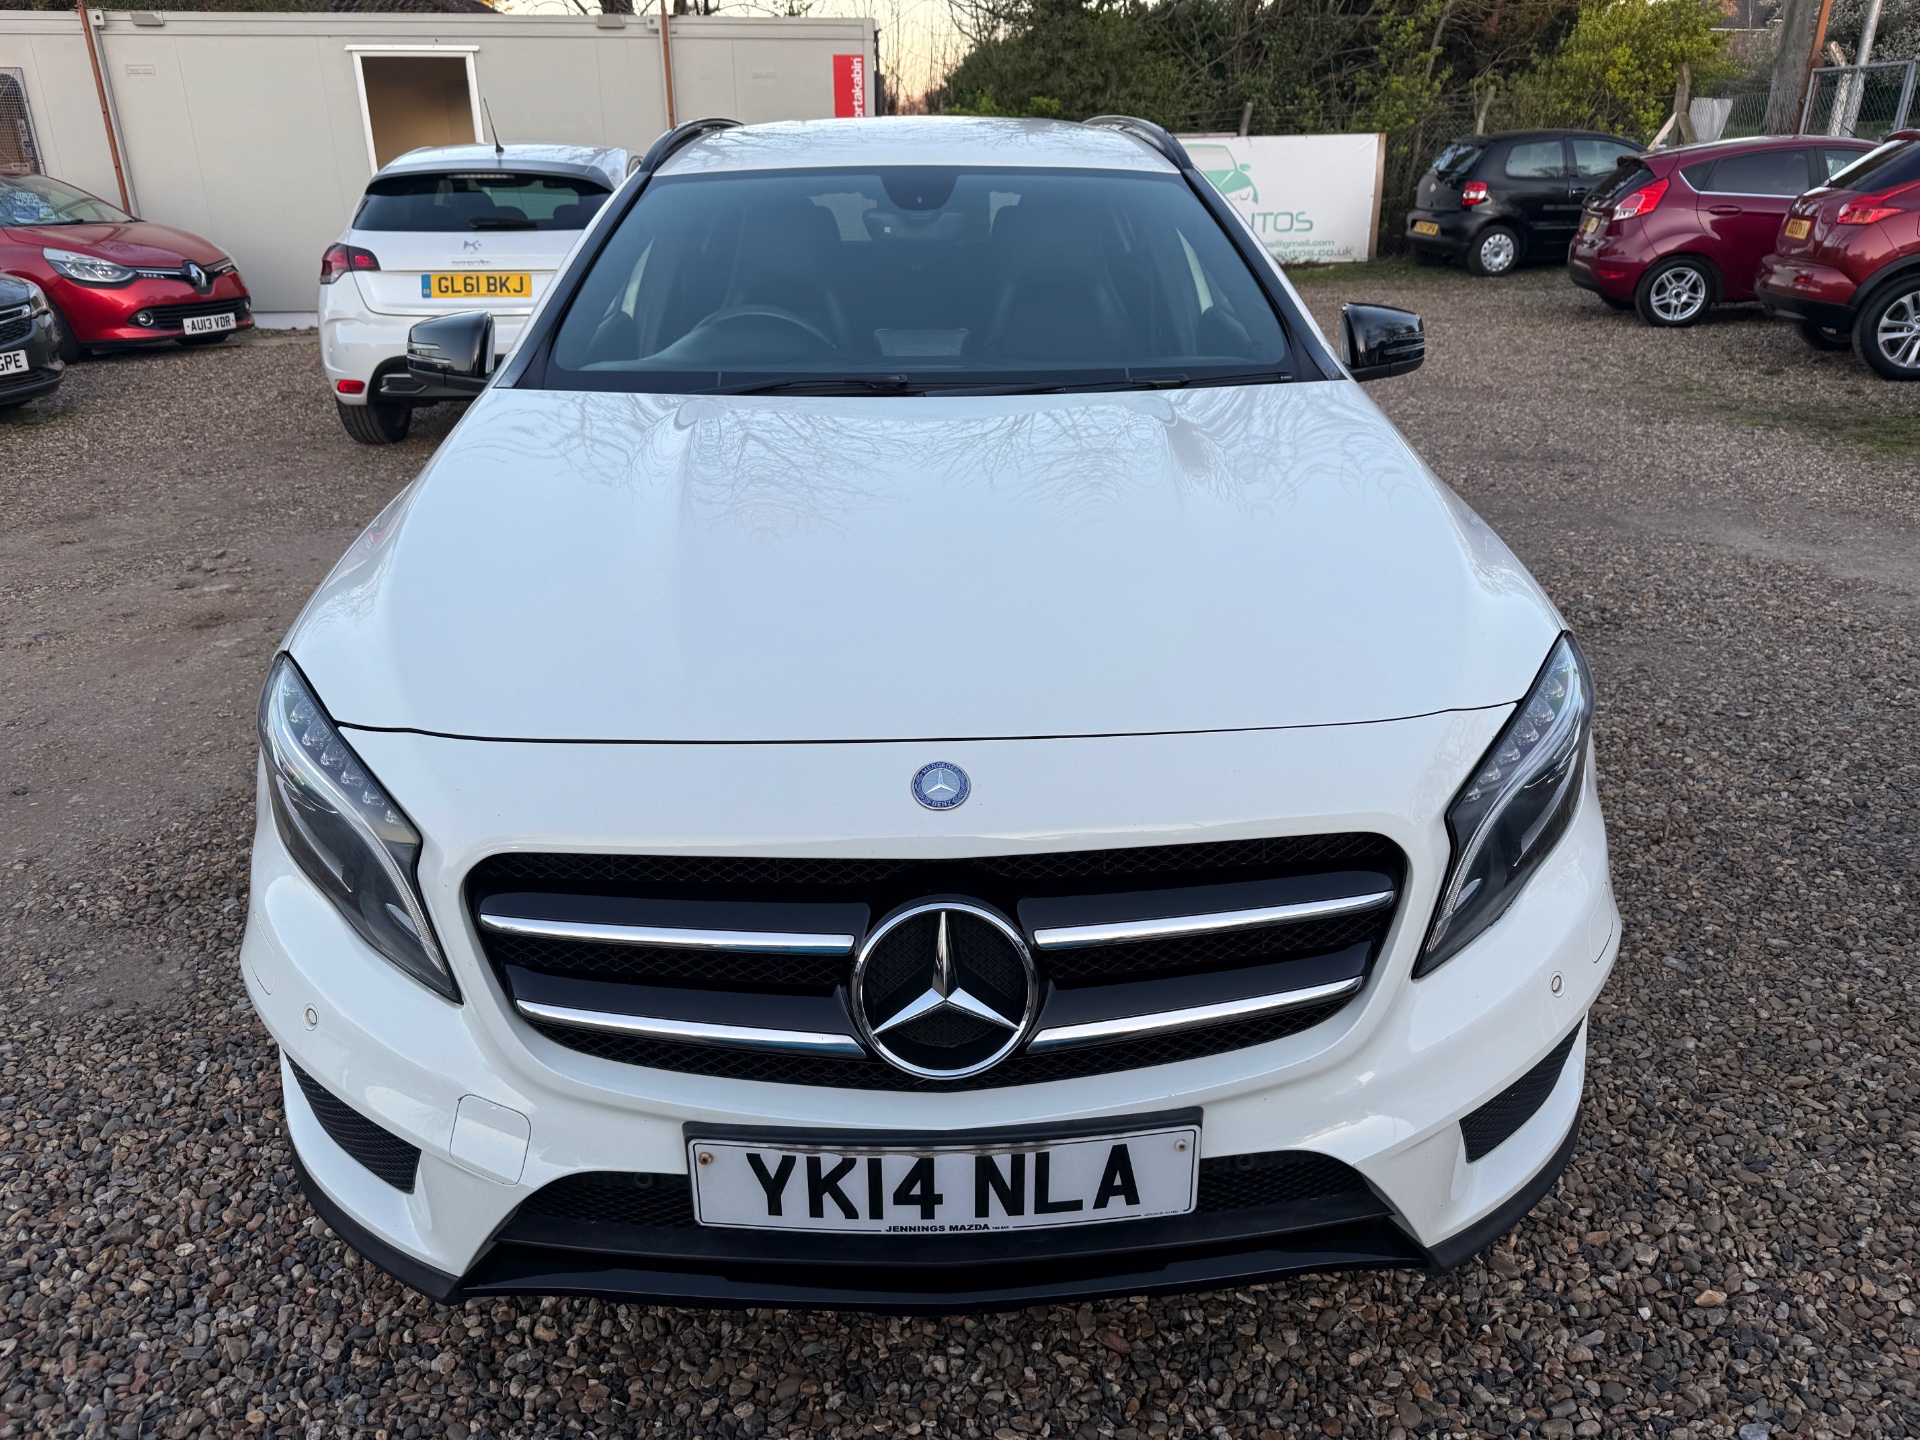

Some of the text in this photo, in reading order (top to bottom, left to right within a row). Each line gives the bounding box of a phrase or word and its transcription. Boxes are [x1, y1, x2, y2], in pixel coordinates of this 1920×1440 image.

[851, 57, 864, 118] ortakabin
[438, 276, 524, 293] GL61 BKJ
[191, 315, 232, 332] AU13 VDR
[746, 1143, 1141, 1220] YK14 NLA
[885, 1225, 946, 1233] JENNINGS
[948, 1223, 991, 1232] MAZDA
